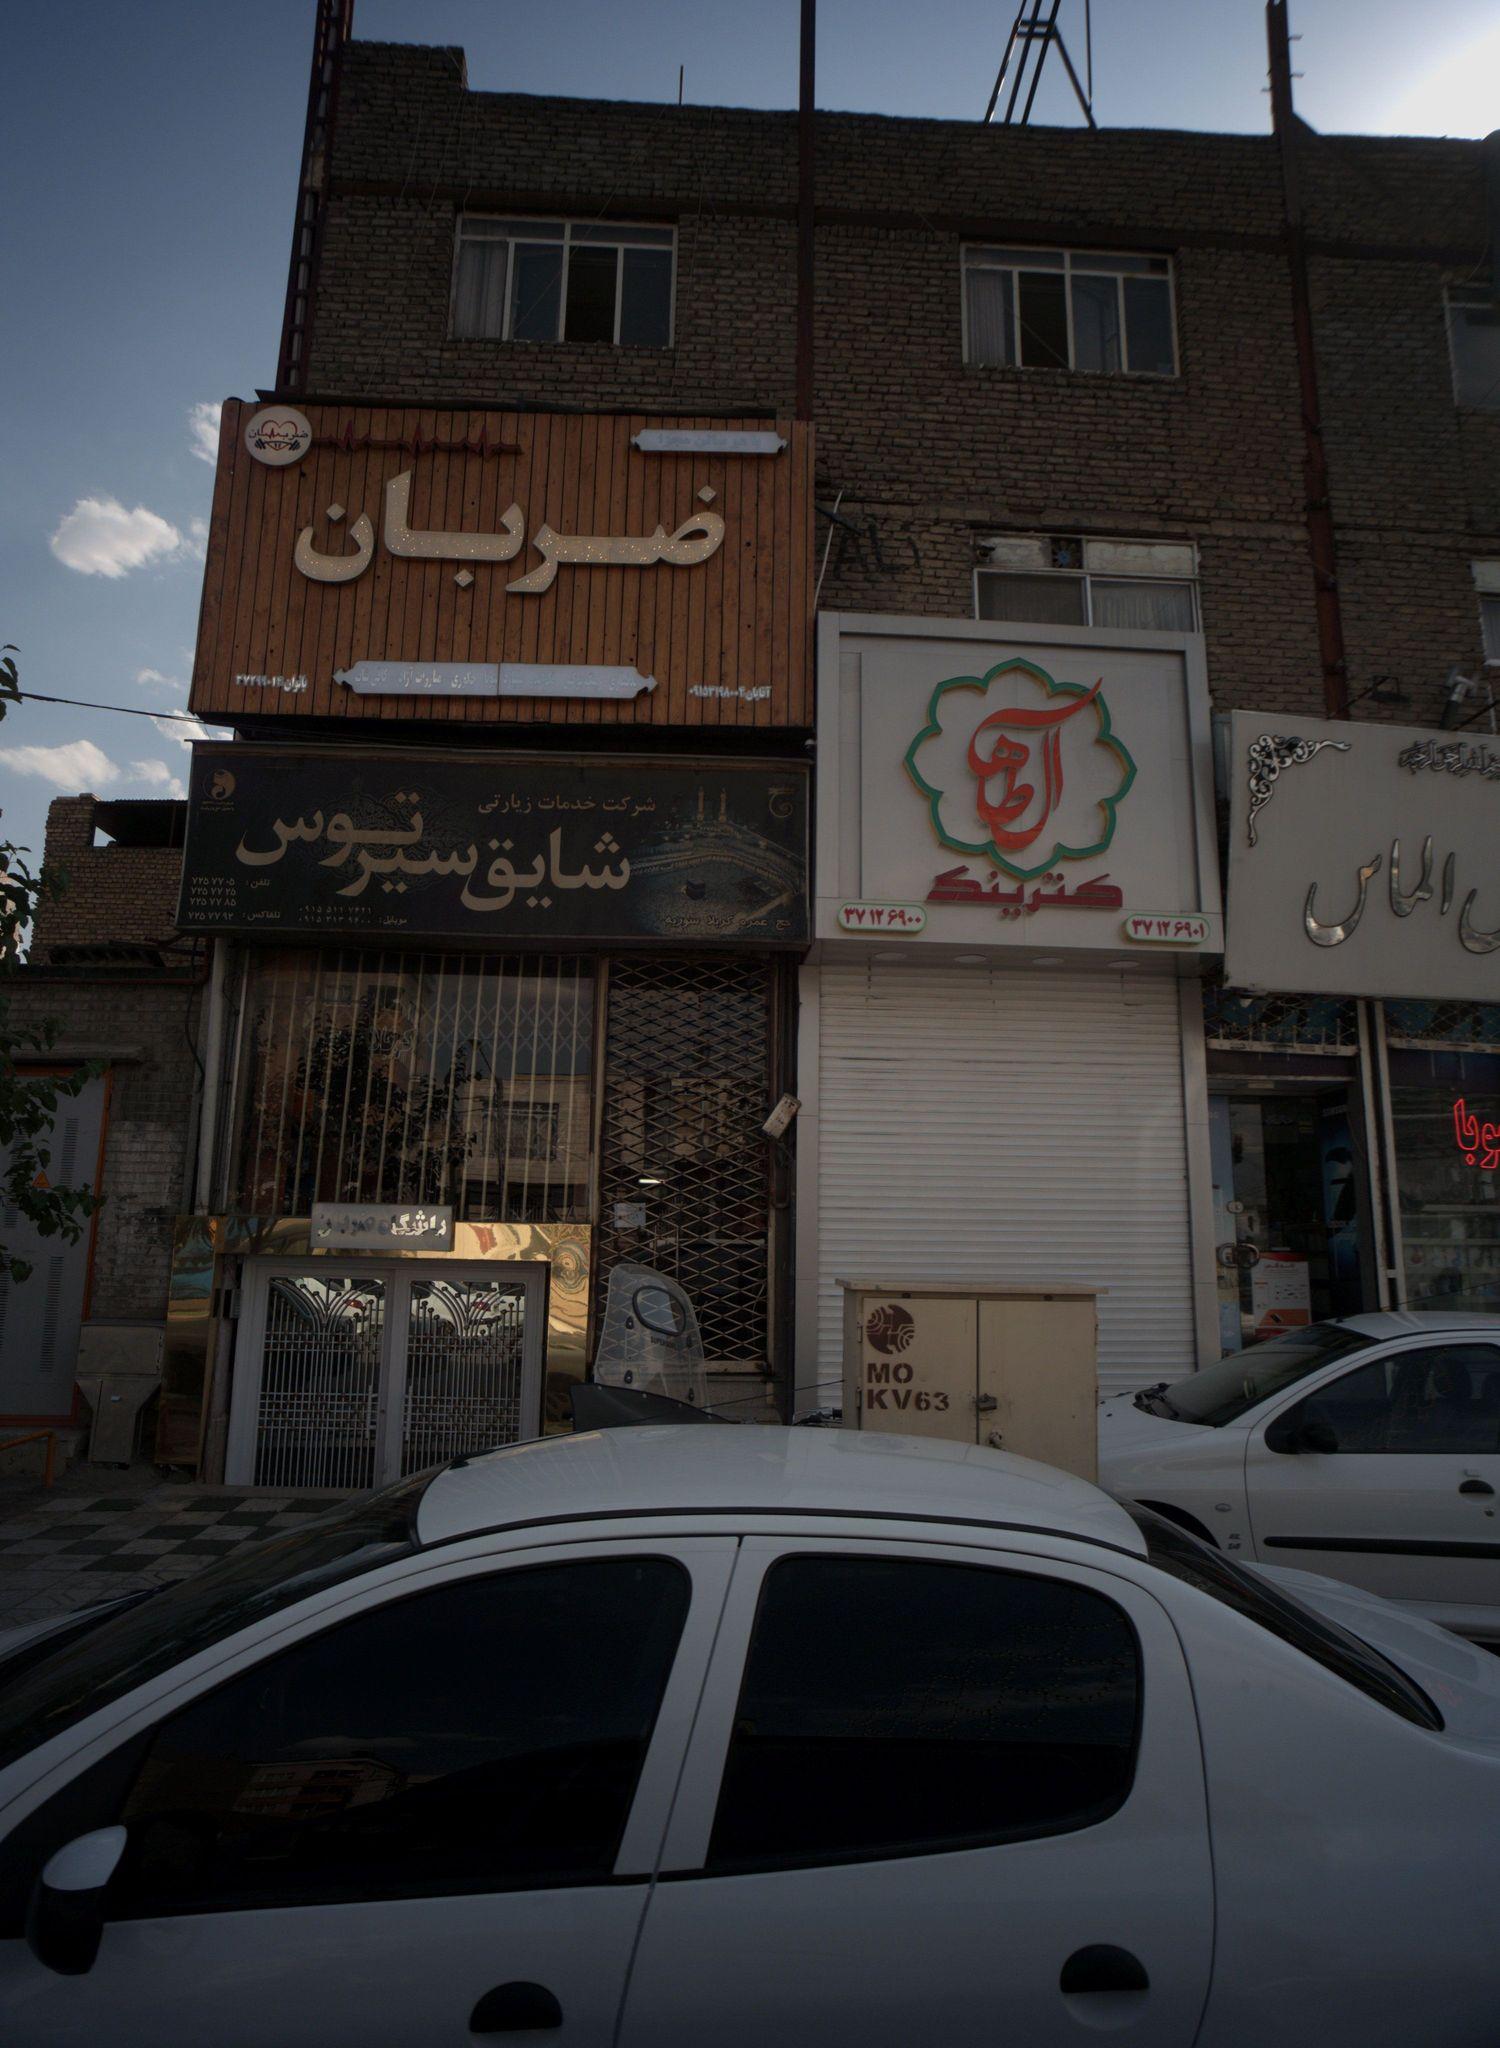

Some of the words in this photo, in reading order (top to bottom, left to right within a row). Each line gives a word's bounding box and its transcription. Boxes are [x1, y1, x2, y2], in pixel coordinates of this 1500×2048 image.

[294, 469, 726, 593] ضربان
[477, 791, 532, 814] زیارتی
[537, 794, 597, 811] خدمات
[602, 794, 657, 817] شرکت
[235, 791, 424, 867] توس
[336, 844, 479, 897] سیر
[460, 826, 631, 912] شایق
[926, 864, 1124, 916] کترینگ
[775, 919, 792, 932] حج
[867, 1363, 914, 1384] MO
[867, 1388, 950, 1412] KV63
